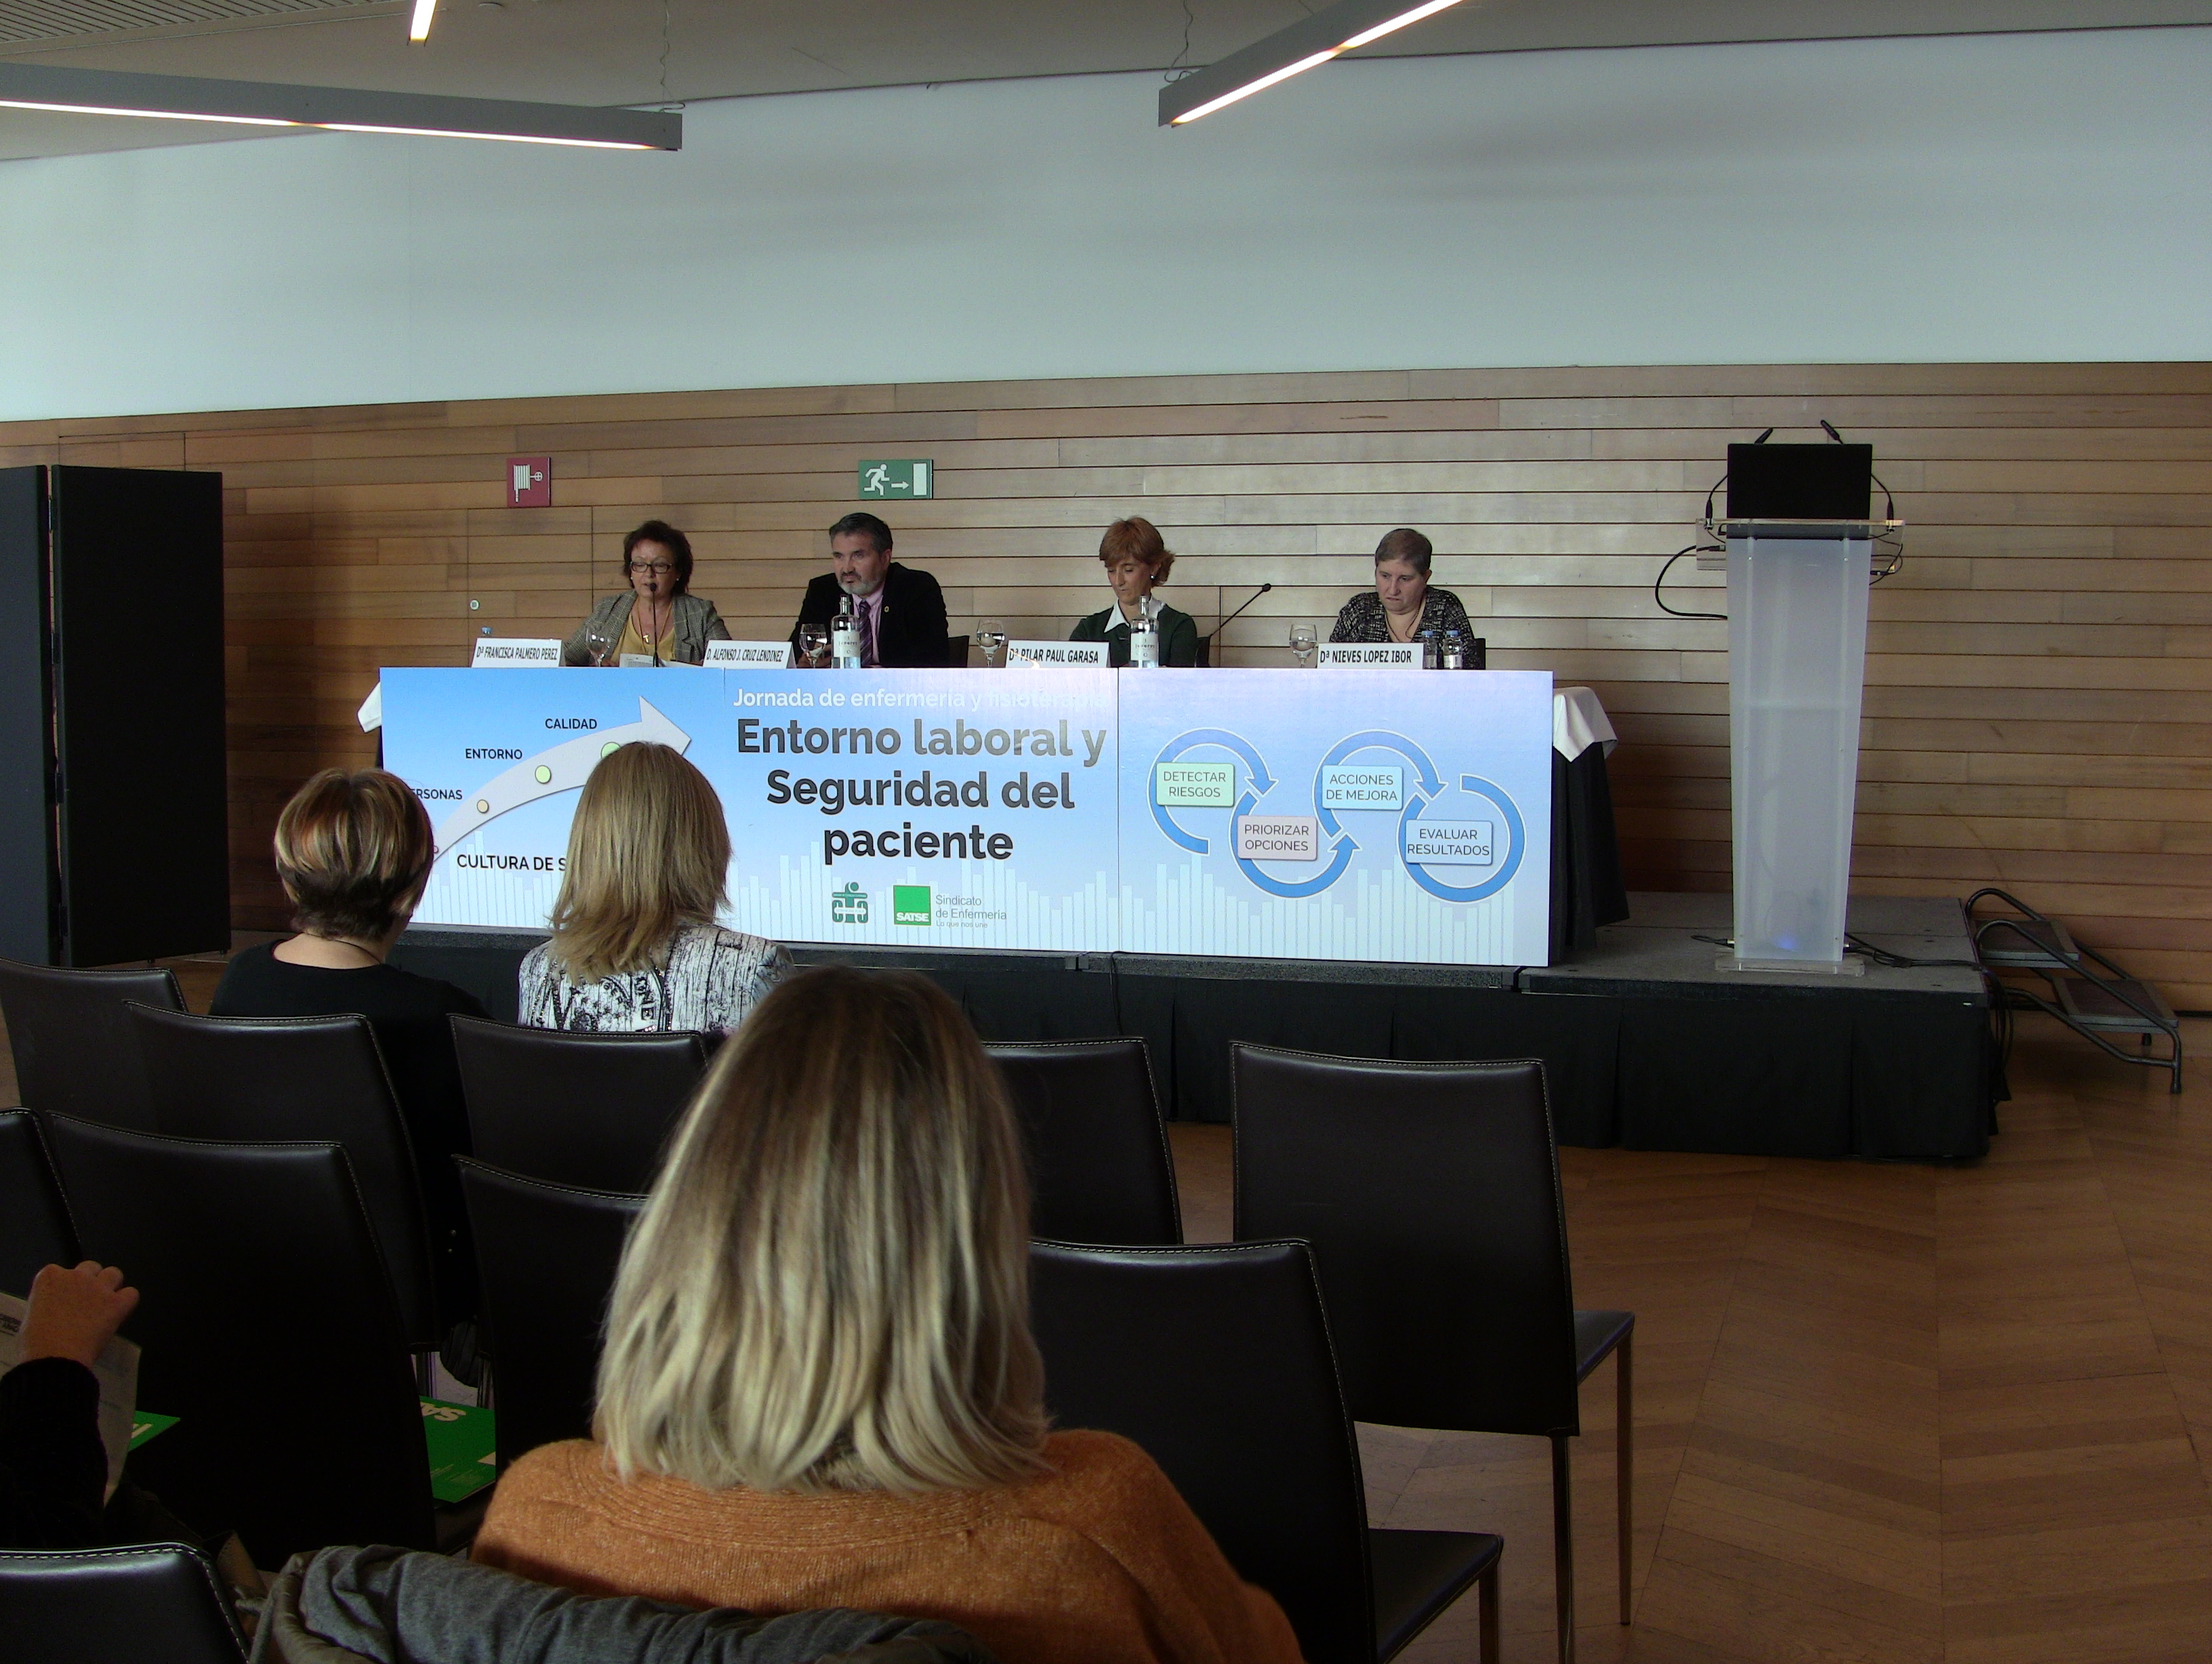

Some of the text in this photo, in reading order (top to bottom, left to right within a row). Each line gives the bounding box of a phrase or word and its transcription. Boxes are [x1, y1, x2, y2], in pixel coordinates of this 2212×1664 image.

[476, 646, 558, 660] Dª FRANCISCA PALMERO PEREZ
[706, 648, 783, 662] D. ALFONSO J. CRUZ LENDINEZ
[1021, 648, 1044, 662] PILAR
[1046, 649, 1065, 662] PAUL
[1067, 649, 1099, 663] GARASA
[1320, 650, 1412, 663] Dª NIEVES LOPEZ IBOR
[733, 688, 816, 707] Jornada
[819, 688, 846, 707] de
[970, 692, 983, 712] y
[545, 718, 598, 730] CALIDAD
[737, 718, 1107, 767] Entorno laboral y
[465, 748, 523, 760] ENTORNO
[1164, 771, 1226, 783] DETECTAR
[1330, 774, 1393, 786] ACCIONES
[410, 789, 463, 800] RSONAS
[767, 770, 1076, 815] Seguridad del
[1168, 787, 1221, 797] RIESGOS
[1326, 789, 1397, 801] DE MEJORA
[1244, 825, 1309, 836] PRIORIZAR
[1419, 829, 1478, 840] EVALUAR
[824, 822, 1014, 865] paciente
[1245, 840, 1309, 851] OPCIONES
[1407, 844, 1490, 856] RESULTADOS
[457, 854, 529, 870] CULTURA
[533, 856, 554, 871] DE
[936, 894, 982, 906] Sindicato
[895, 912, 930, 923] SATSE
[936, 908, 1007, 919] de Enfermería
